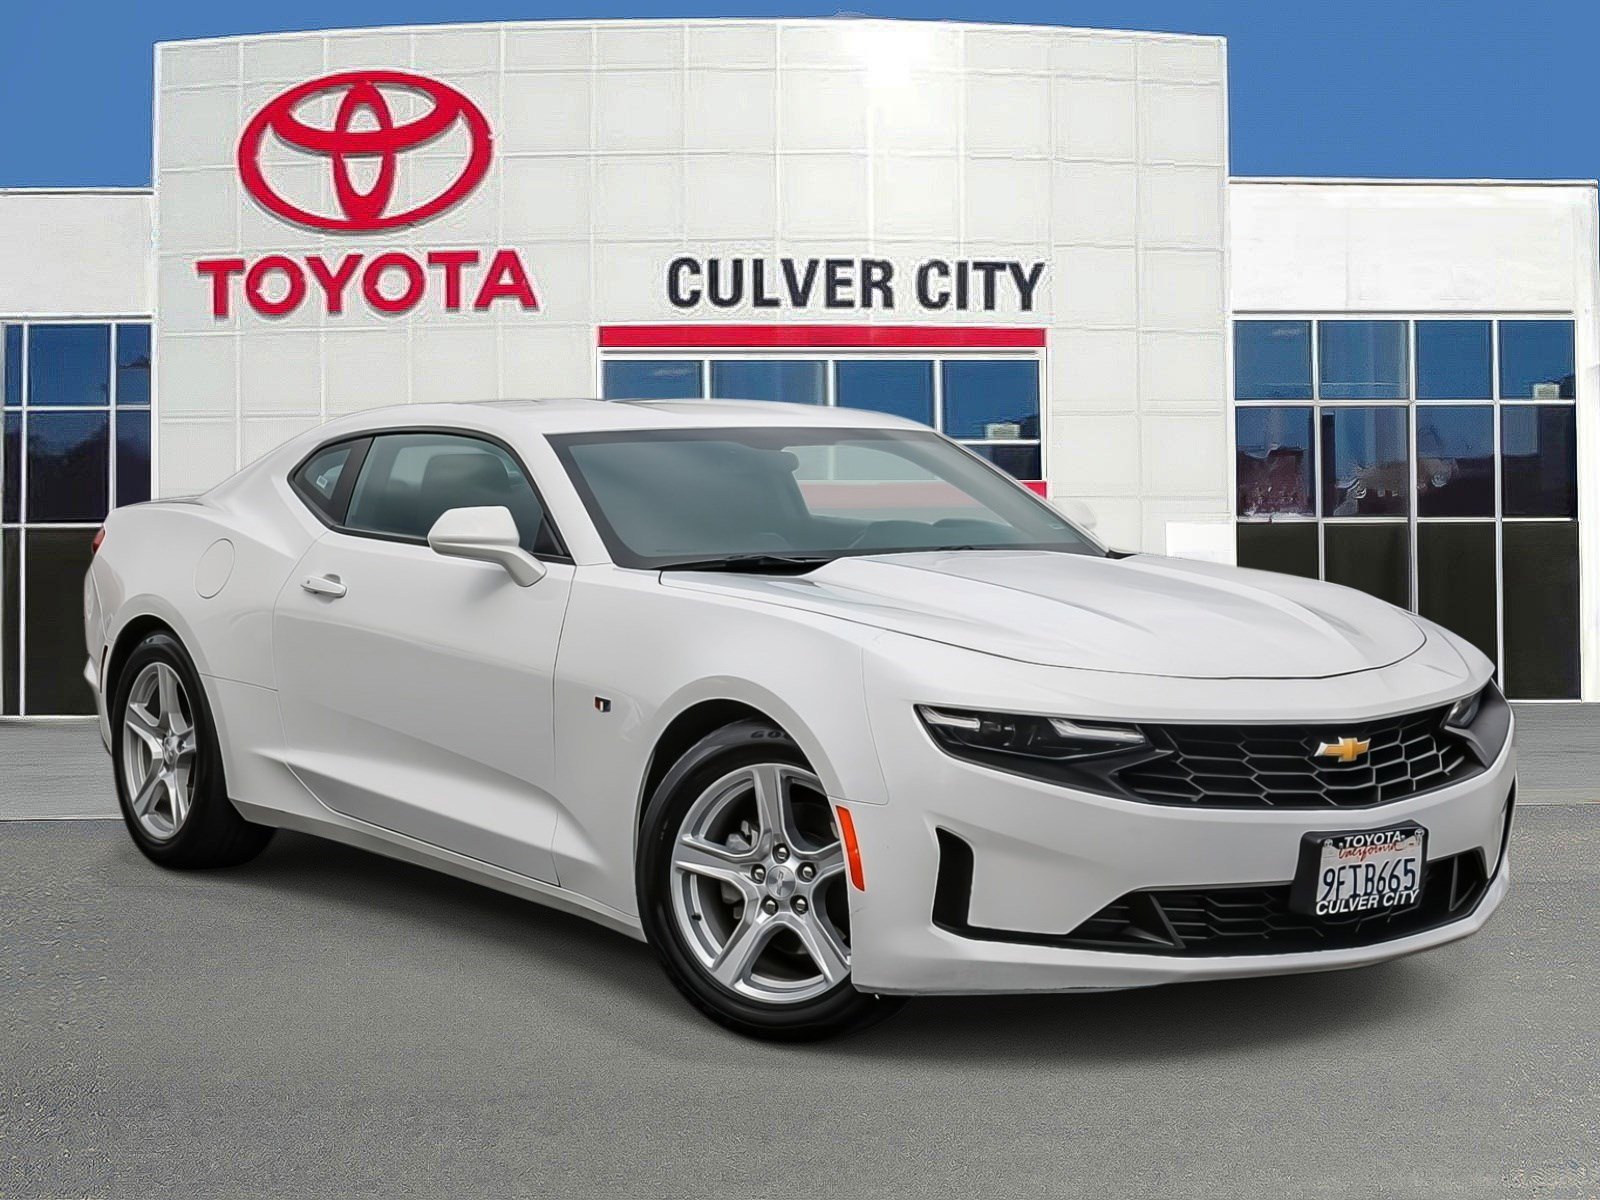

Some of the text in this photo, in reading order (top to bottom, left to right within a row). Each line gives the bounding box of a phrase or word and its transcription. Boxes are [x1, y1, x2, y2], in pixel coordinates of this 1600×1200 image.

[195, 249, 539, 319] TOYOTA
[667, 256, 1046, 311] CULVER CITY
[1344, 830, 1401, 848] TOYOTA
[1316, 889, 1420, 915] CULVER CITY
[1320, 858, 1416, 902] 9FIB665
